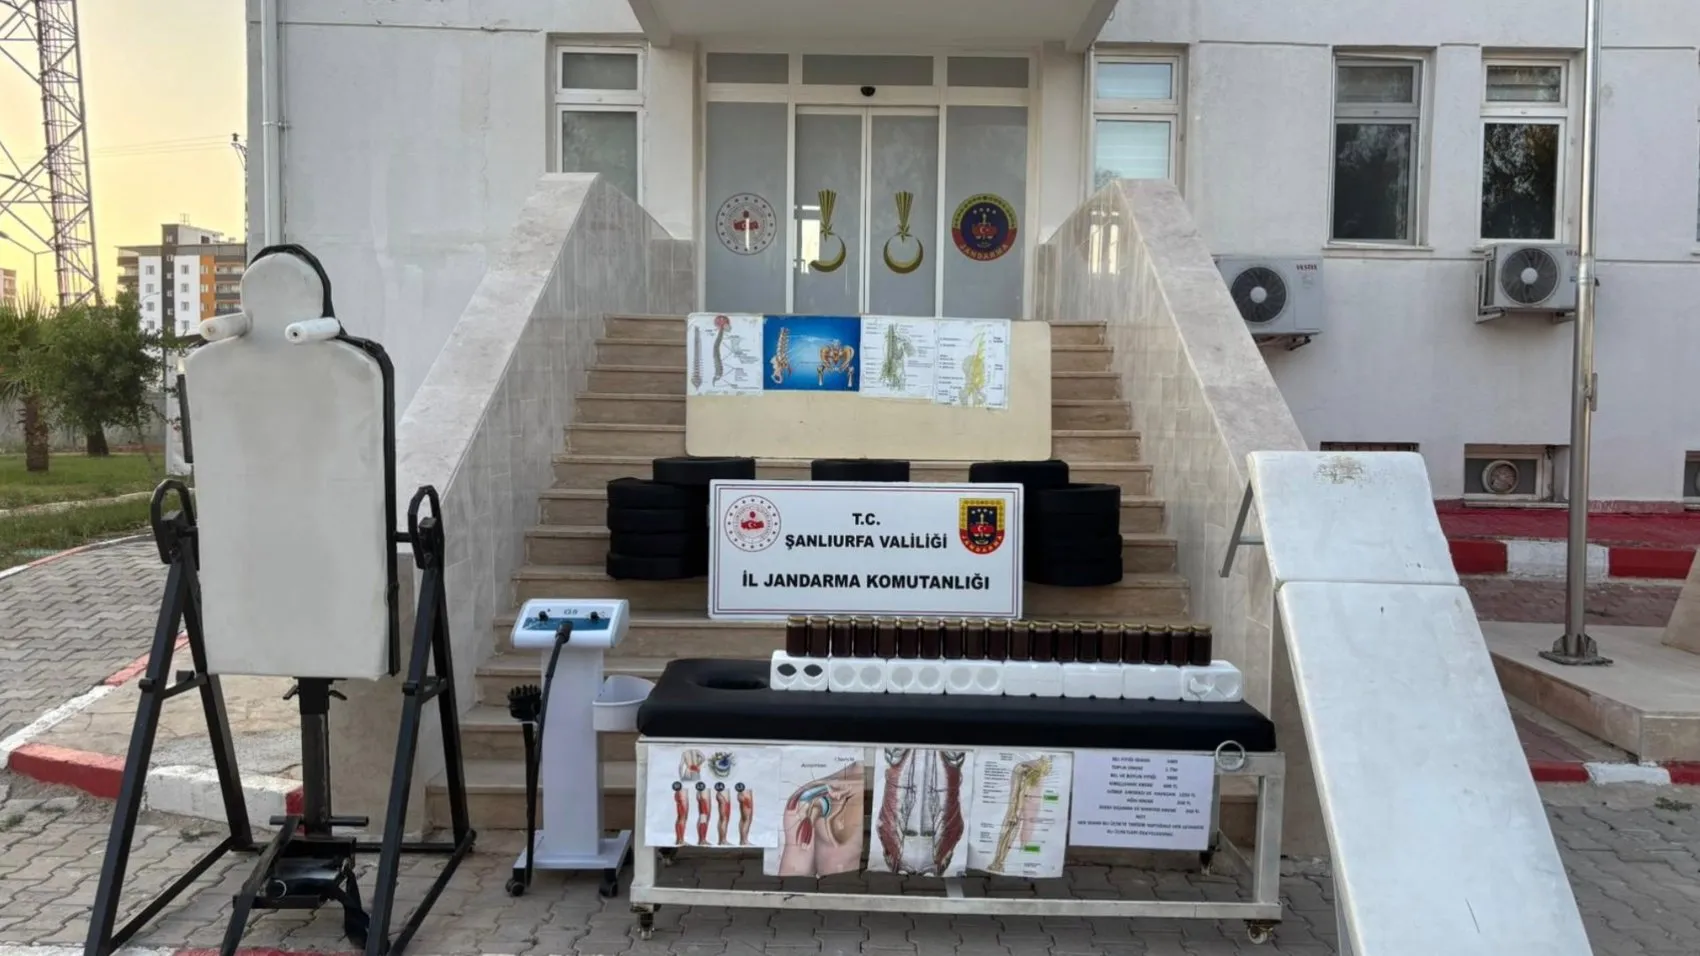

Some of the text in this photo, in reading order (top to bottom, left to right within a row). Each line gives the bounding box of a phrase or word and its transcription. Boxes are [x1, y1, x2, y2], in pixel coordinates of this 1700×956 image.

[852, 513, 880, 525] T.C.
[785, 533, 947, 550] ŞANLIURFA VALİLİĞİ
[743, 570, 989, 590] İL JANDARMA KOMUTANLIĞI
